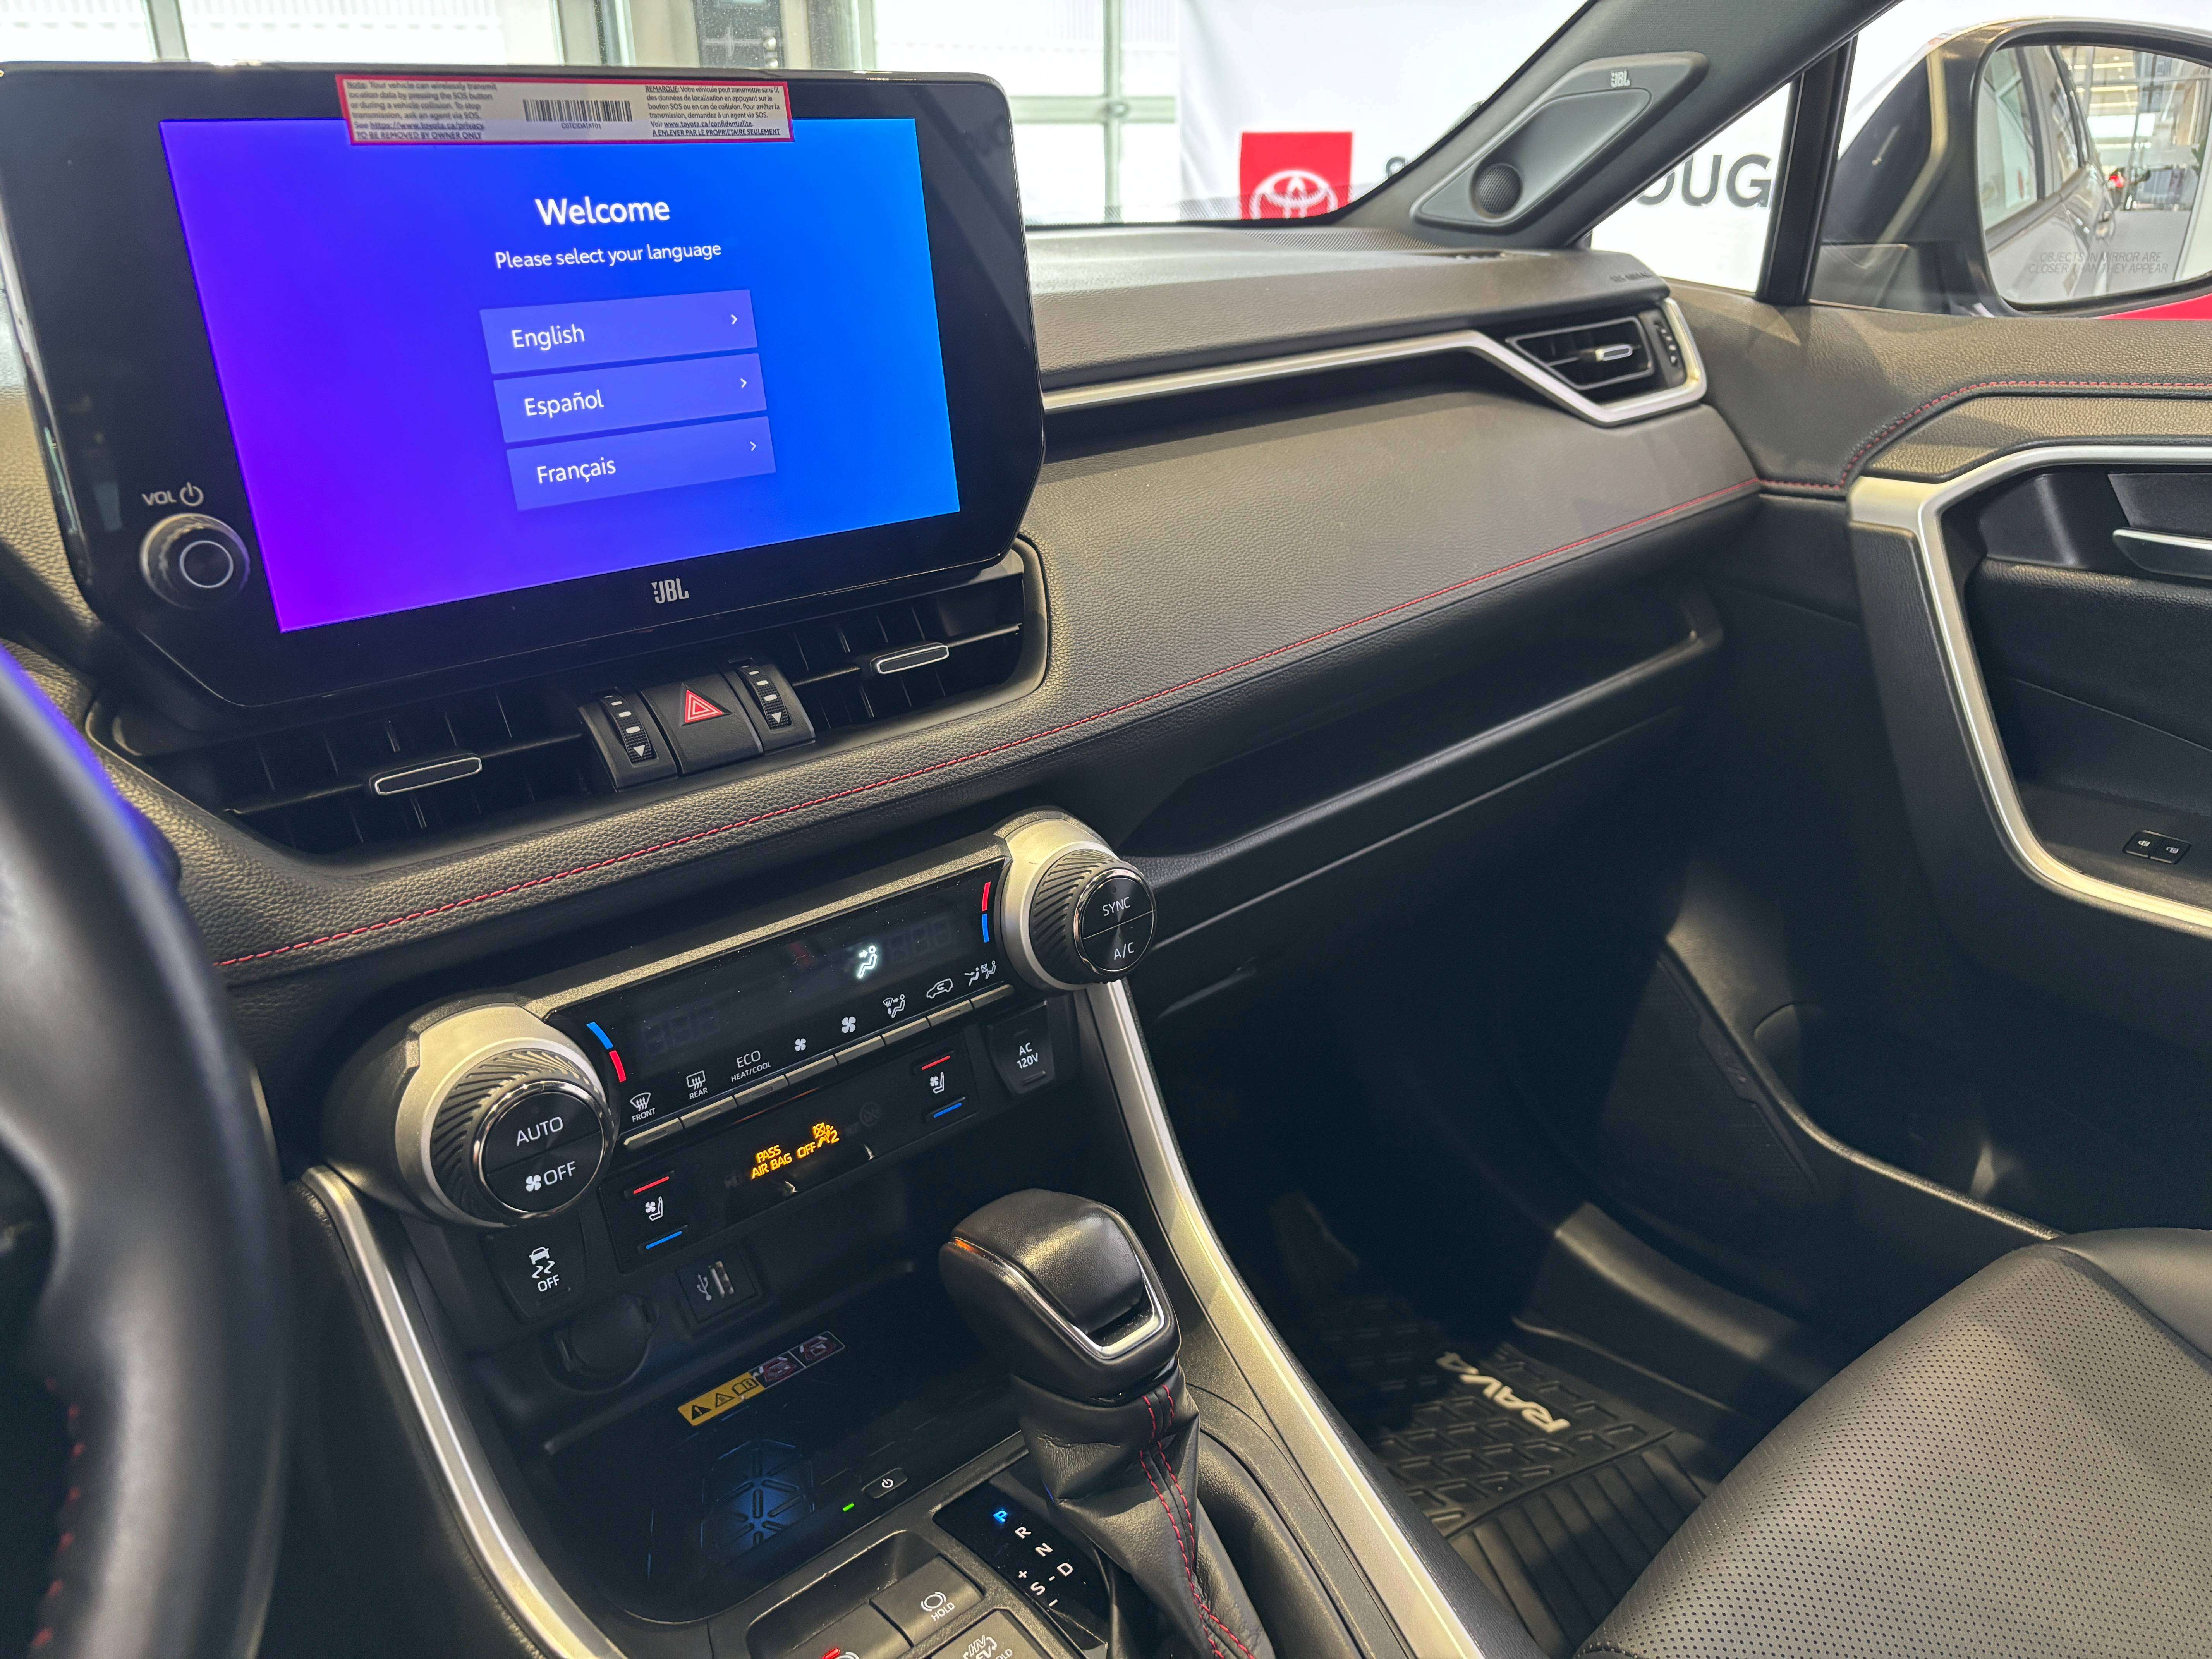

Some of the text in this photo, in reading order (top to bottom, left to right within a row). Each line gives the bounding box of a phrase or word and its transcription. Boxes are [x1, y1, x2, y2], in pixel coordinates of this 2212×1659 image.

[1611, 71, 1630, 88] JBL
[535, 196, 670, 226] Welcome
[495, 243, 722, 269] Please select your language
[2041, 252, 2086, 262] OBJECTS
[2142, 252, 2163, 262] ARE
[2029, 263, 2069, 273] CLOSER
[2130, 263, 2168, 273] APPEAR
[511, 323, 585, 351] English
[524, 389, 605, 418] Español
[536, 457, 616, 484] Français
[142, 490, 177, 506] VOL
[651, 578, 689, 604] JBL
[1103, 896, 1130, 917] SYNC
[1114, 942, 1134, 960] A/C
[1019, 1042, 1032, 1056] AC
[737, 1050, 761, 1068] ECO
[1017, 1053, 1038, 1069] 120V
[731, 1061, 771, 1082] HEAT/COOL
[689, 1087, 708, 1099] REAR
[632, 1108, 656, 1123] FRONT
[516, 1116, 563, 1146] AUTO
[751, 1142, 816, 1180] AIR BAG OFF
[756, 1144, 781, 1163] PASS
[543, 1161, 576, 1185] OFF
[537, 1274, 560, 1292] OFF
[1436, 1352, 1570, 1433] RAV4
[993, 1510, 1008, 1523] P
[1015, 1526, 1032, 1539] R
[1035, 1542, 1053, 1557] N
[1056, 1563, 1073, 1577] D
[1030, 1581, 1046, 1596] S
[931, 1602, 955, 1621] HOLD
[968, 1634, 986, 1657] HV
